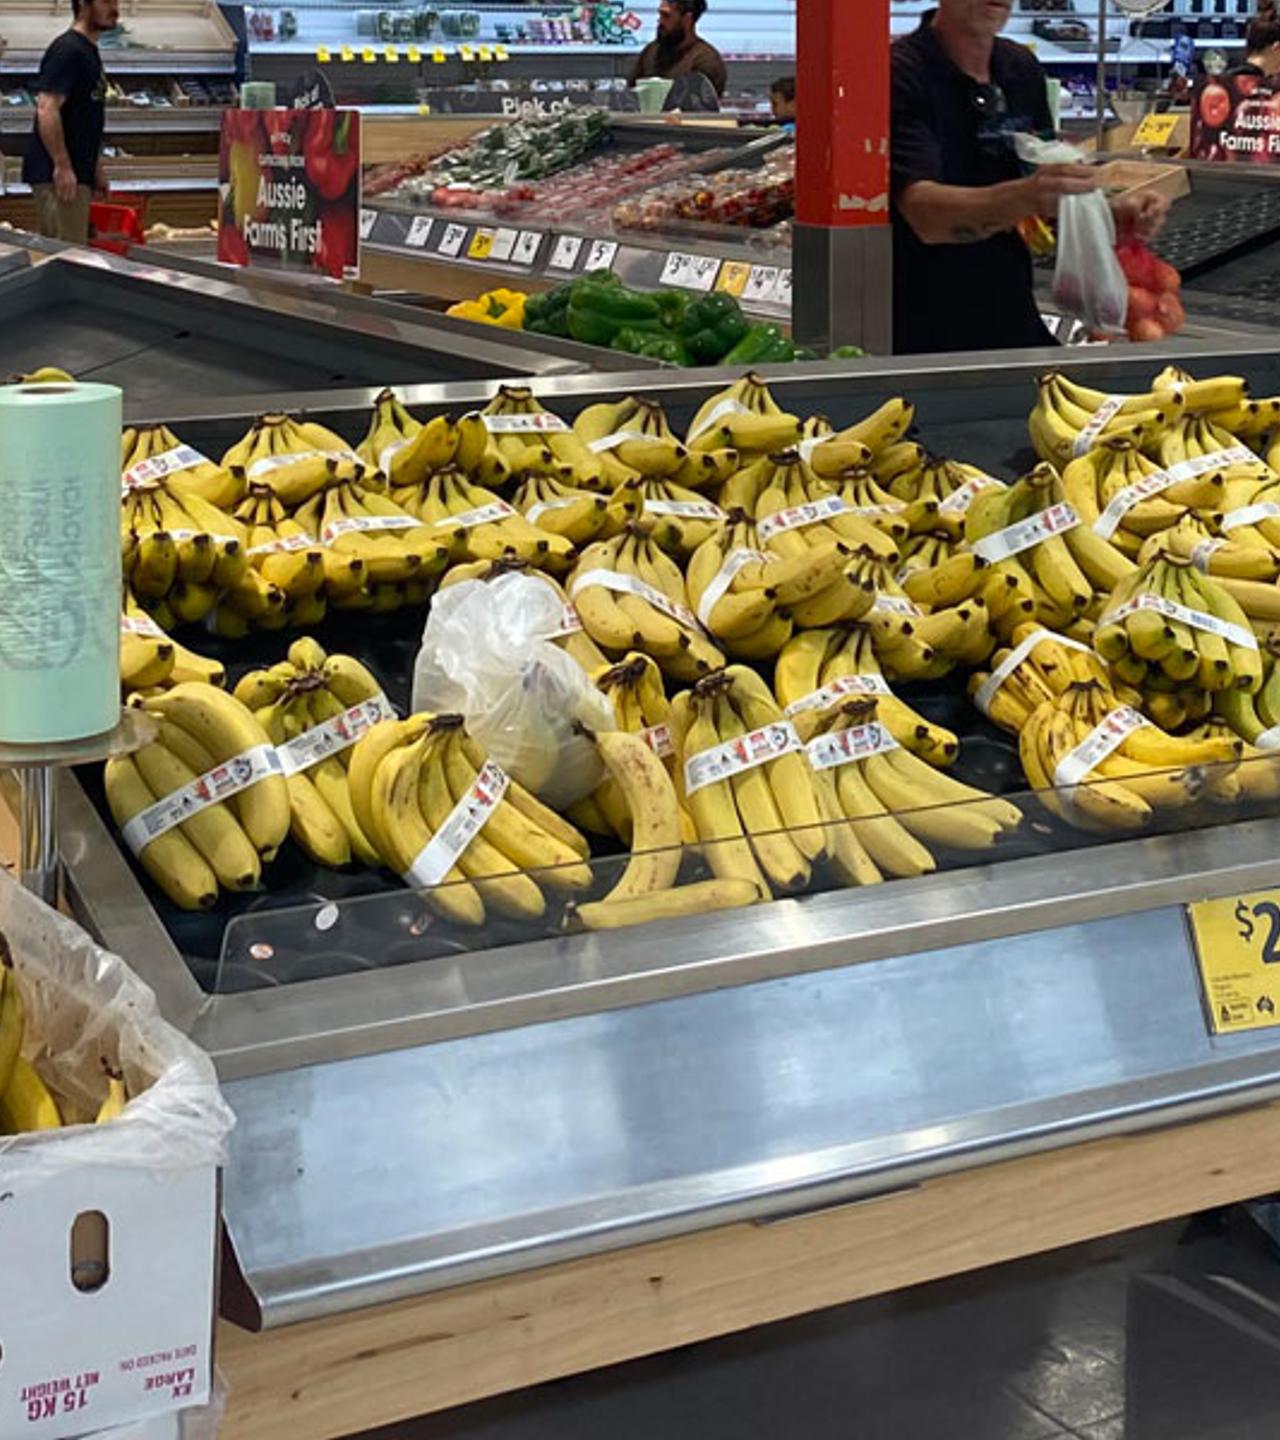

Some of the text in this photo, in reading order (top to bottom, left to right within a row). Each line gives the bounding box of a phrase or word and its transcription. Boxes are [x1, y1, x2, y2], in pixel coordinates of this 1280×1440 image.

[1220, 132, 1265, 153] Farms
[257, 175, 306, 209] Aussie
[244, 214, 323, 253] Farms First
[20, 1372, 99, 1402] NET WEIGHT
[144, 1367, 195, 1390] LARGE
[172, 1382, 192, 1399] EX
[27, 1389, 87, 1421] 15 KG
